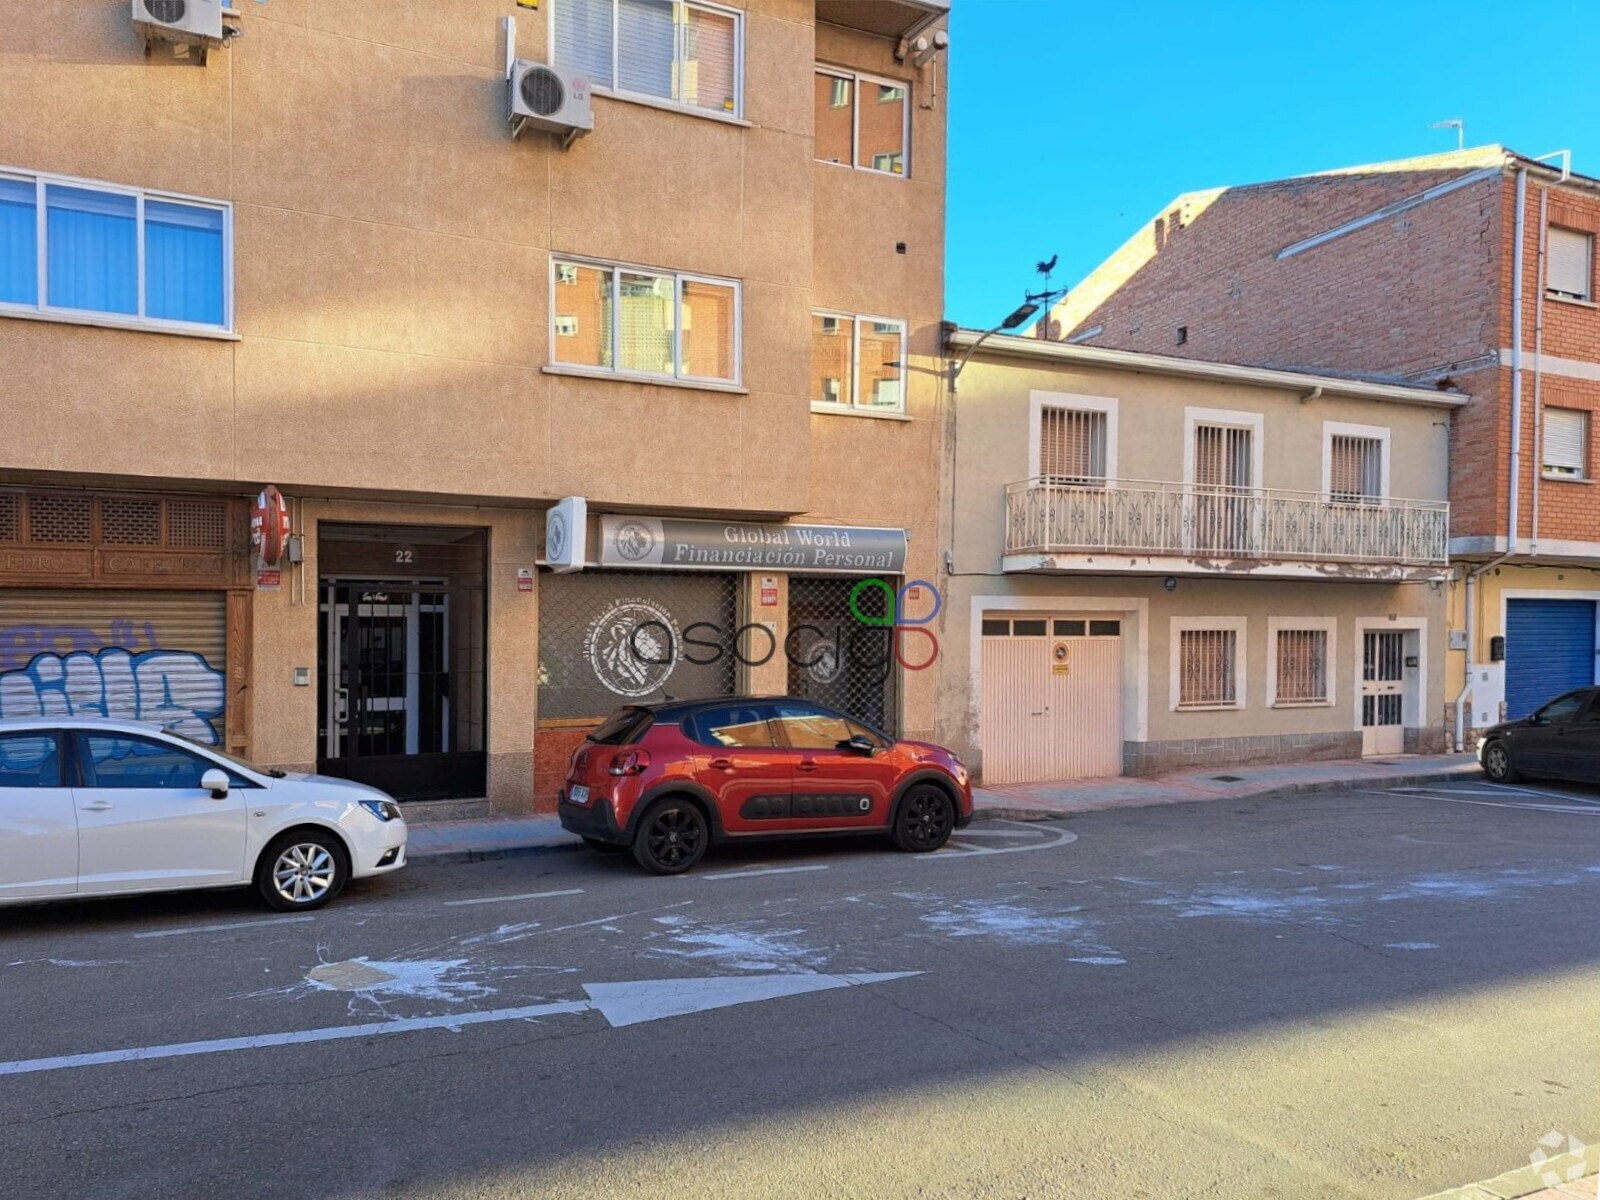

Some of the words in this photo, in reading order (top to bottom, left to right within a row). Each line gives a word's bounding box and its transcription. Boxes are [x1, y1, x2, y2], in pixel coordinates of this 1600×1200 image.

[573, 92, 584, 101] LG
[723, 526, 790, 545] Global
[795, 529, 852, 547] World
[395, 550, 413, 563] 22
[674, 543, 806, 565] Financiación
[812, 548, 893, 568] Personal
